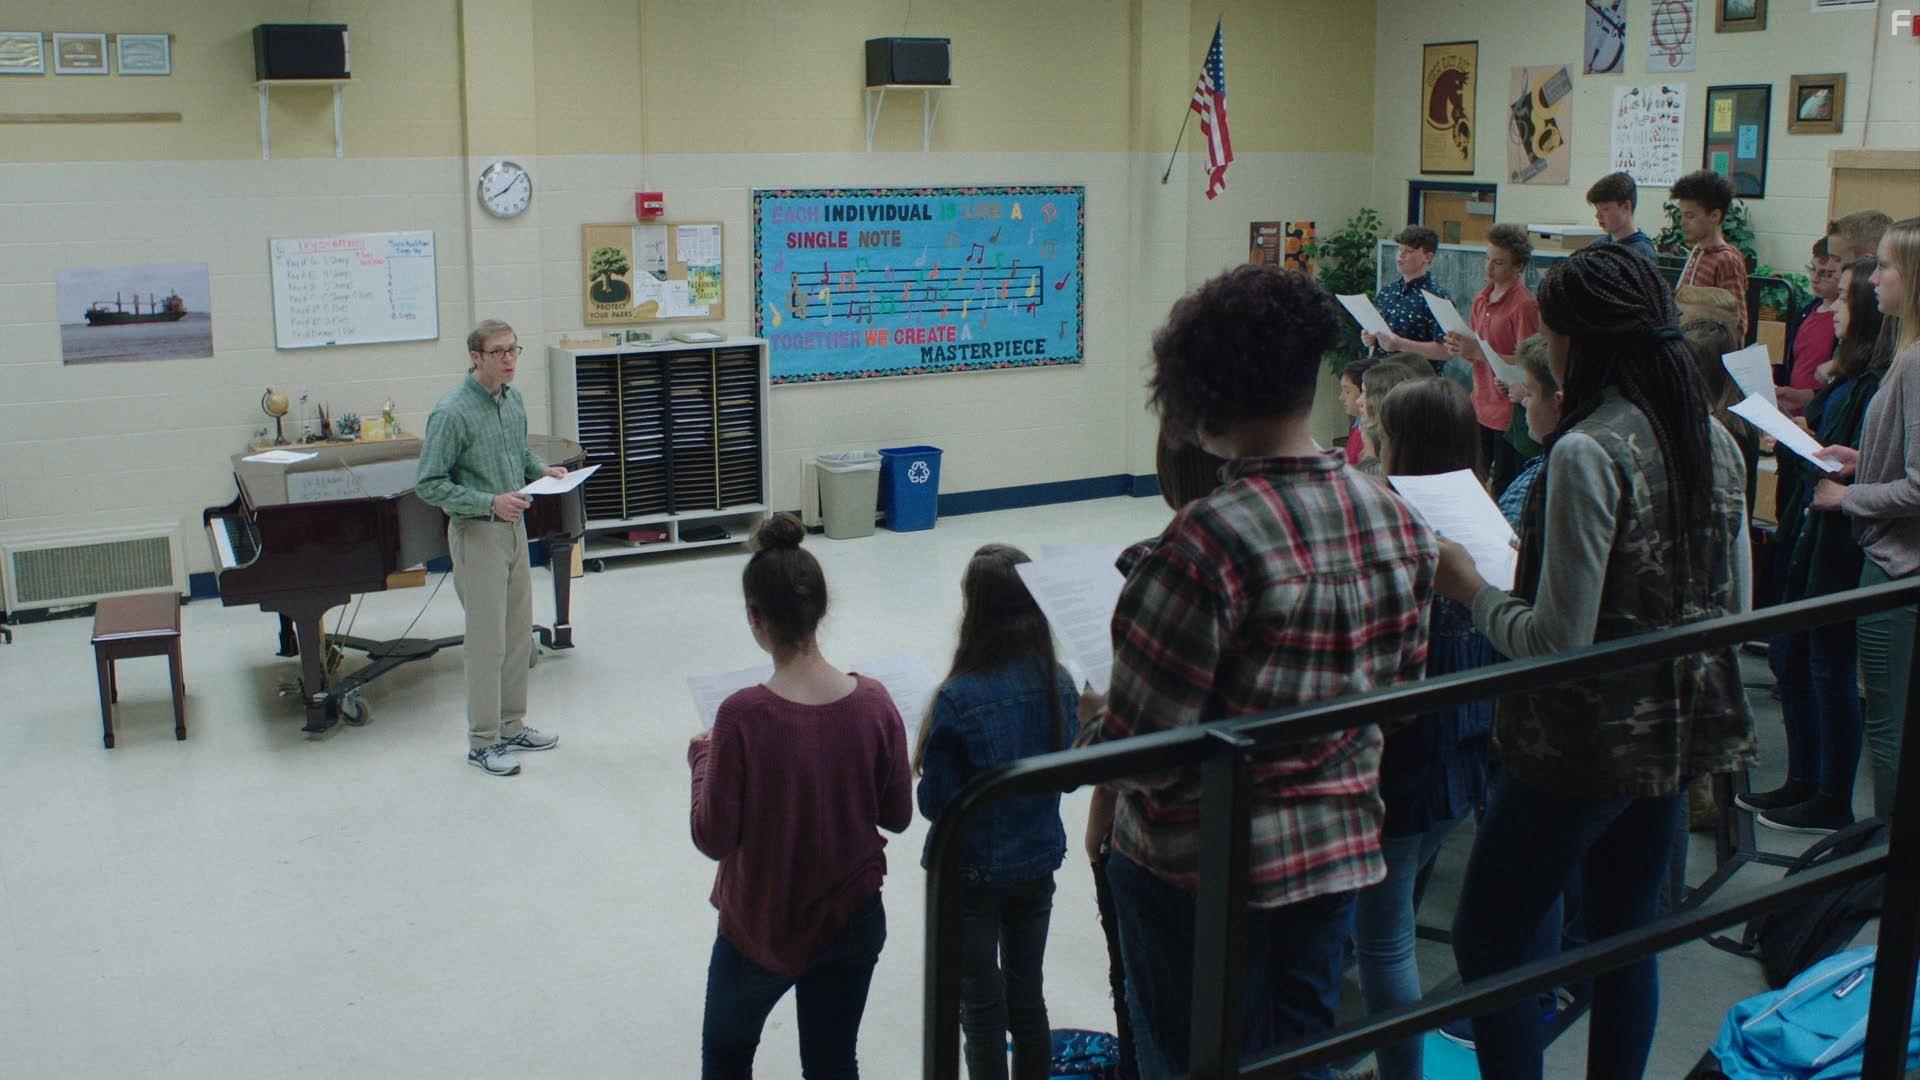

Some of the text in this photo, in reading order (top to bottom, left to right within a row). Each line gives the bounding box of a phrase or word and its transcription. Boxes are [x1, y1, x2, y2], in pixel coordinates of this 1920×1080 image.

[771, 202, 1023, 224] EACH INDIVIDUAL IS LIKE A
[786, 230, 902, 249] SINGLE NOTE
[590, 310, 633, 319] YOUR PARKS
[596, 303, 626, 311] PROTECT
[772, 325, 973, 351] TOGETHER WE CREATE A
[920, 338, 1047, 363] MASTERPIECE
